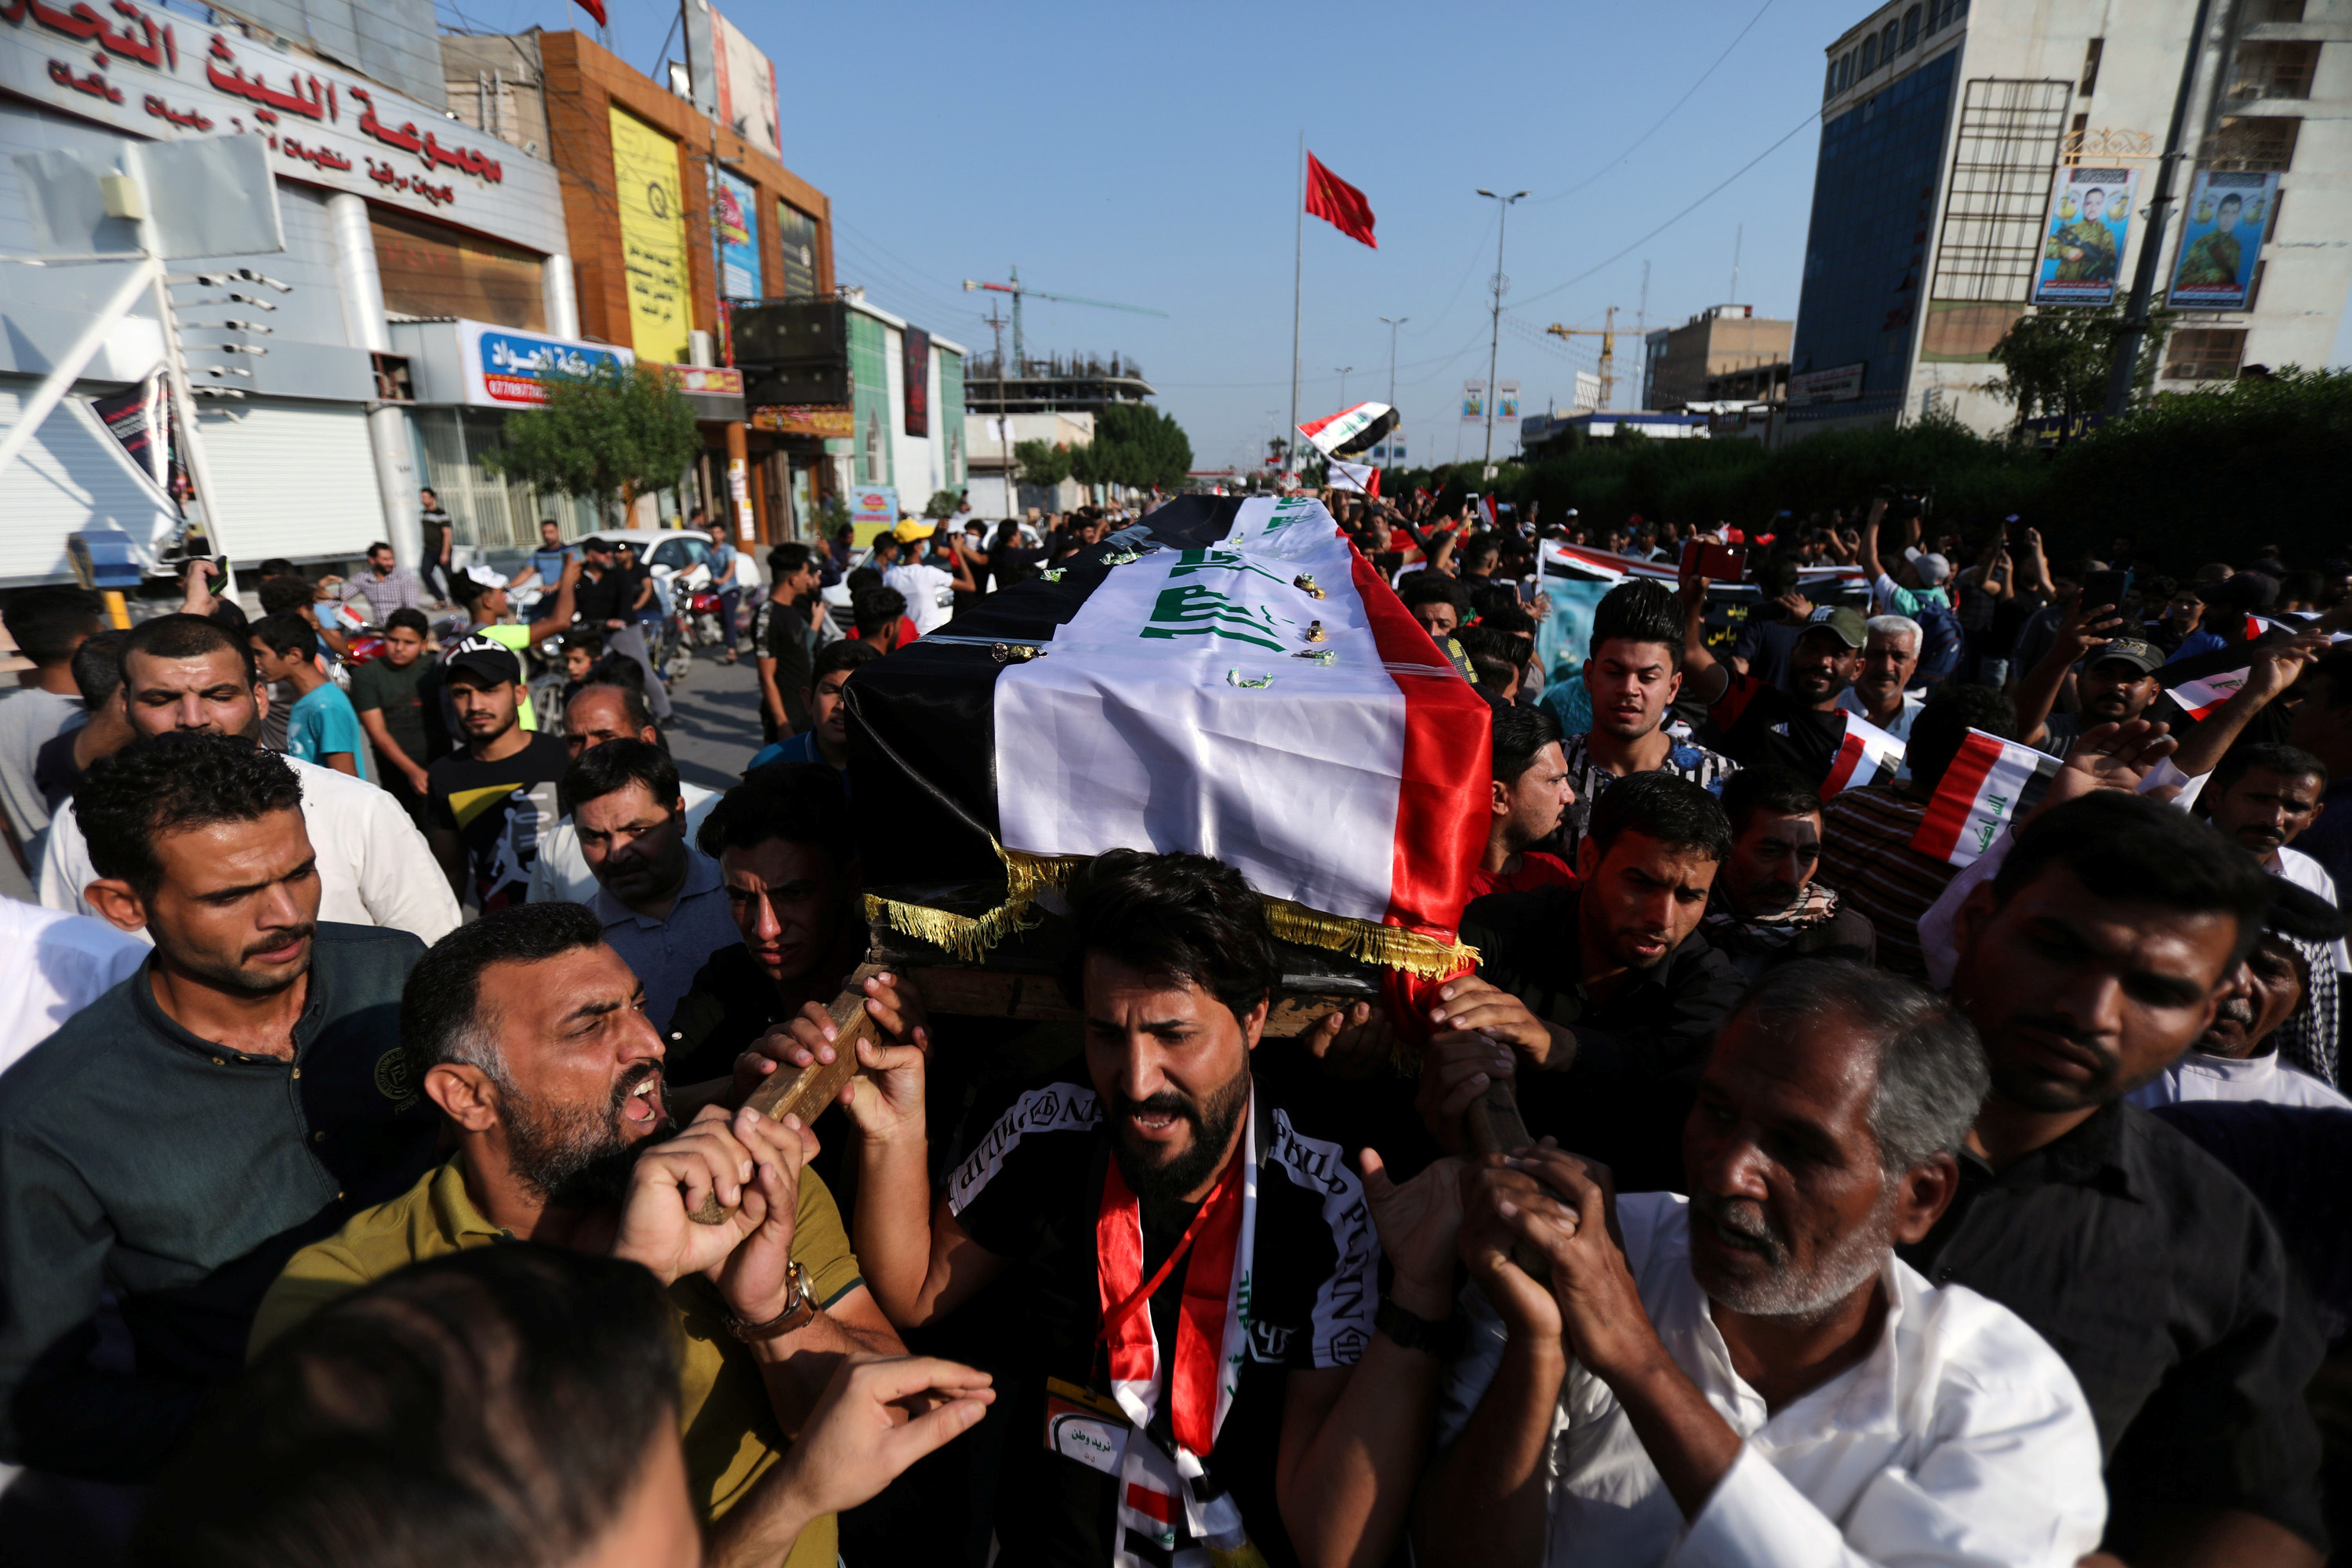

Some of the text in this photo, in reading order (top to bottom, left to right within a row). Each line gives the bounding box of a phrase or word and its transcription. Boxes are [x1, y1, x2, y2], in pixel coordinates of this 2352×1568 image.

[206, 33, 339, 125] الليث
[350, 86, 503, 183] مجموعة
[445, 636, 508, 666] FILA
[1139, 584, 1295, 652] الله
[1071, 1428, 1111, 1452] نريد وطن
